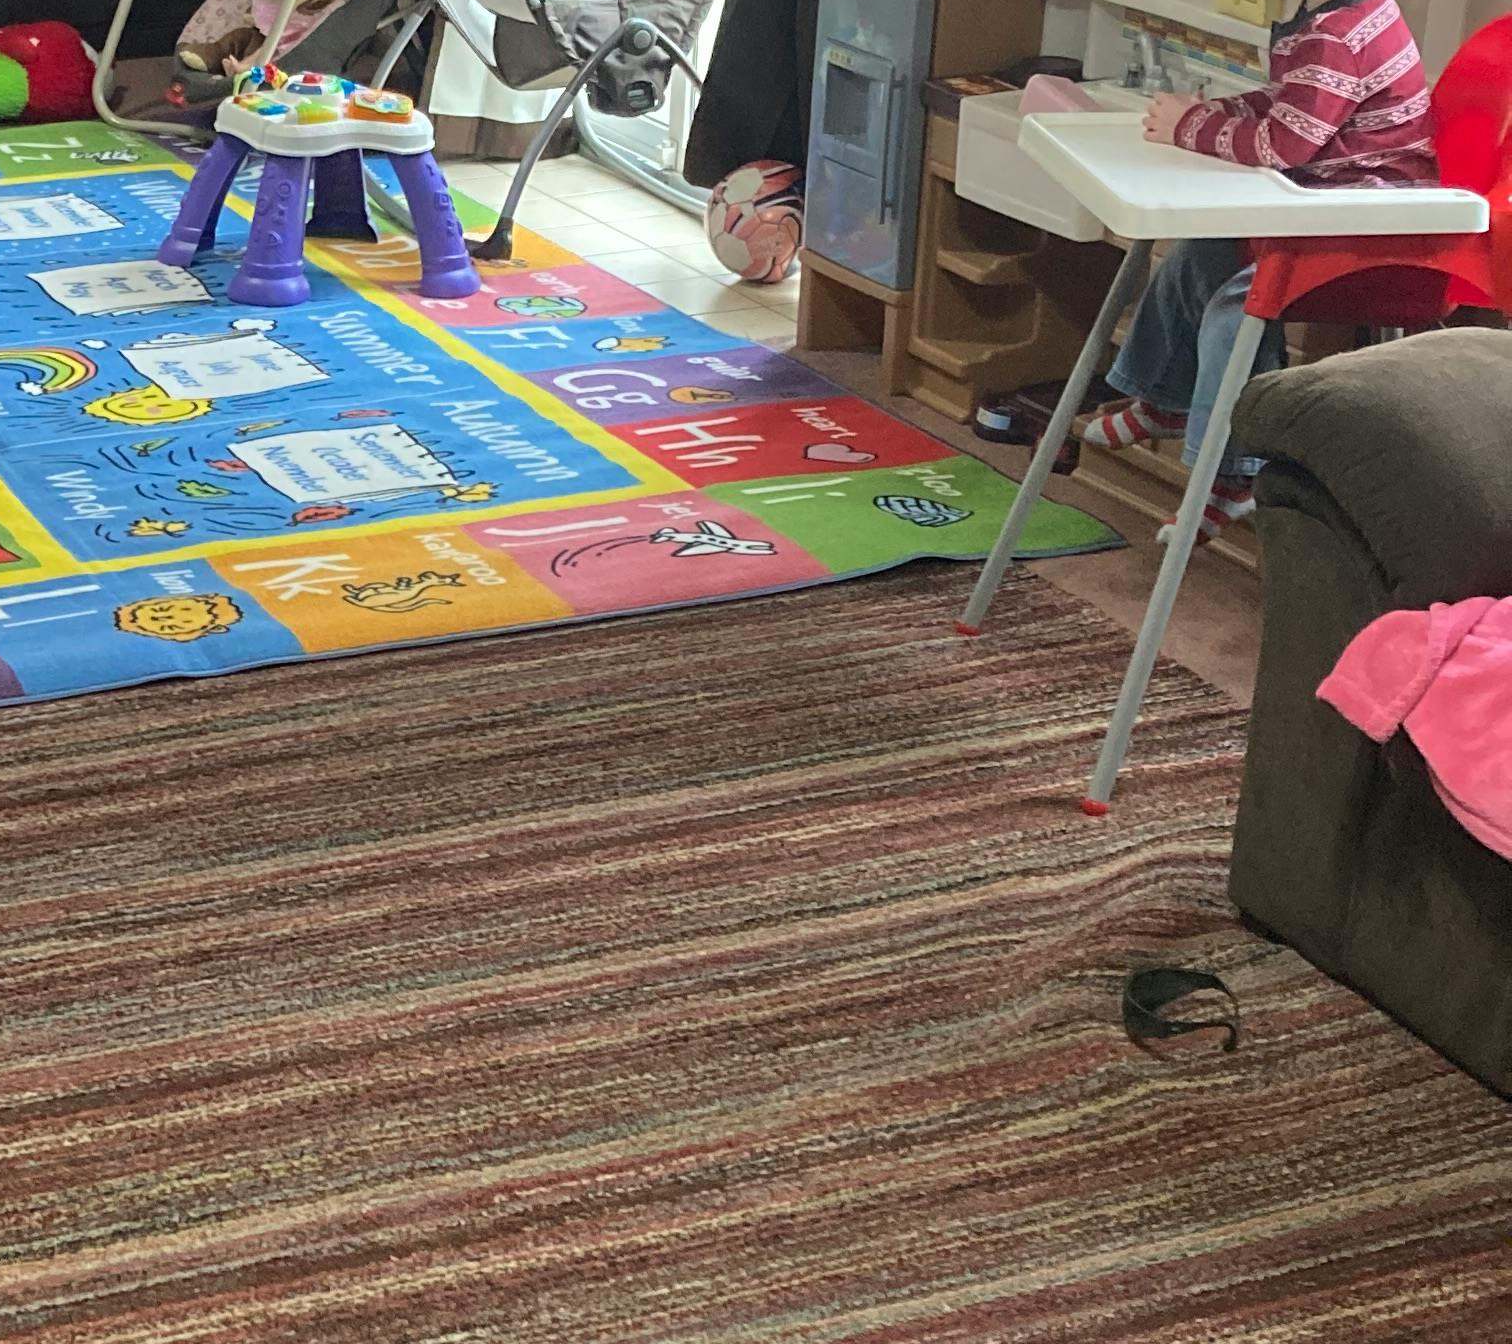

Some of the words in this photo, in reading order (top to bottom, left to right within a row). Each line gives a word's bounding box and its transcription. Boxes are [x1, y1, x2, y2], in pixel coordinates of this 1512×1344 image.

[307, 310, 444, 385] Summer
[429, 399, 580, 483] Autumn
[633, 416, 766, 469] Hh
[790, 406, 859, 439] heart
[256, 445, 330, 494] November
[311, 447, 371, 482] October
[45, 469, 129, 521] Windy
[638, 500, 702, 520] jet
[149, 569, 196, 594] lion
[232, 553, 365, 602] Kk
